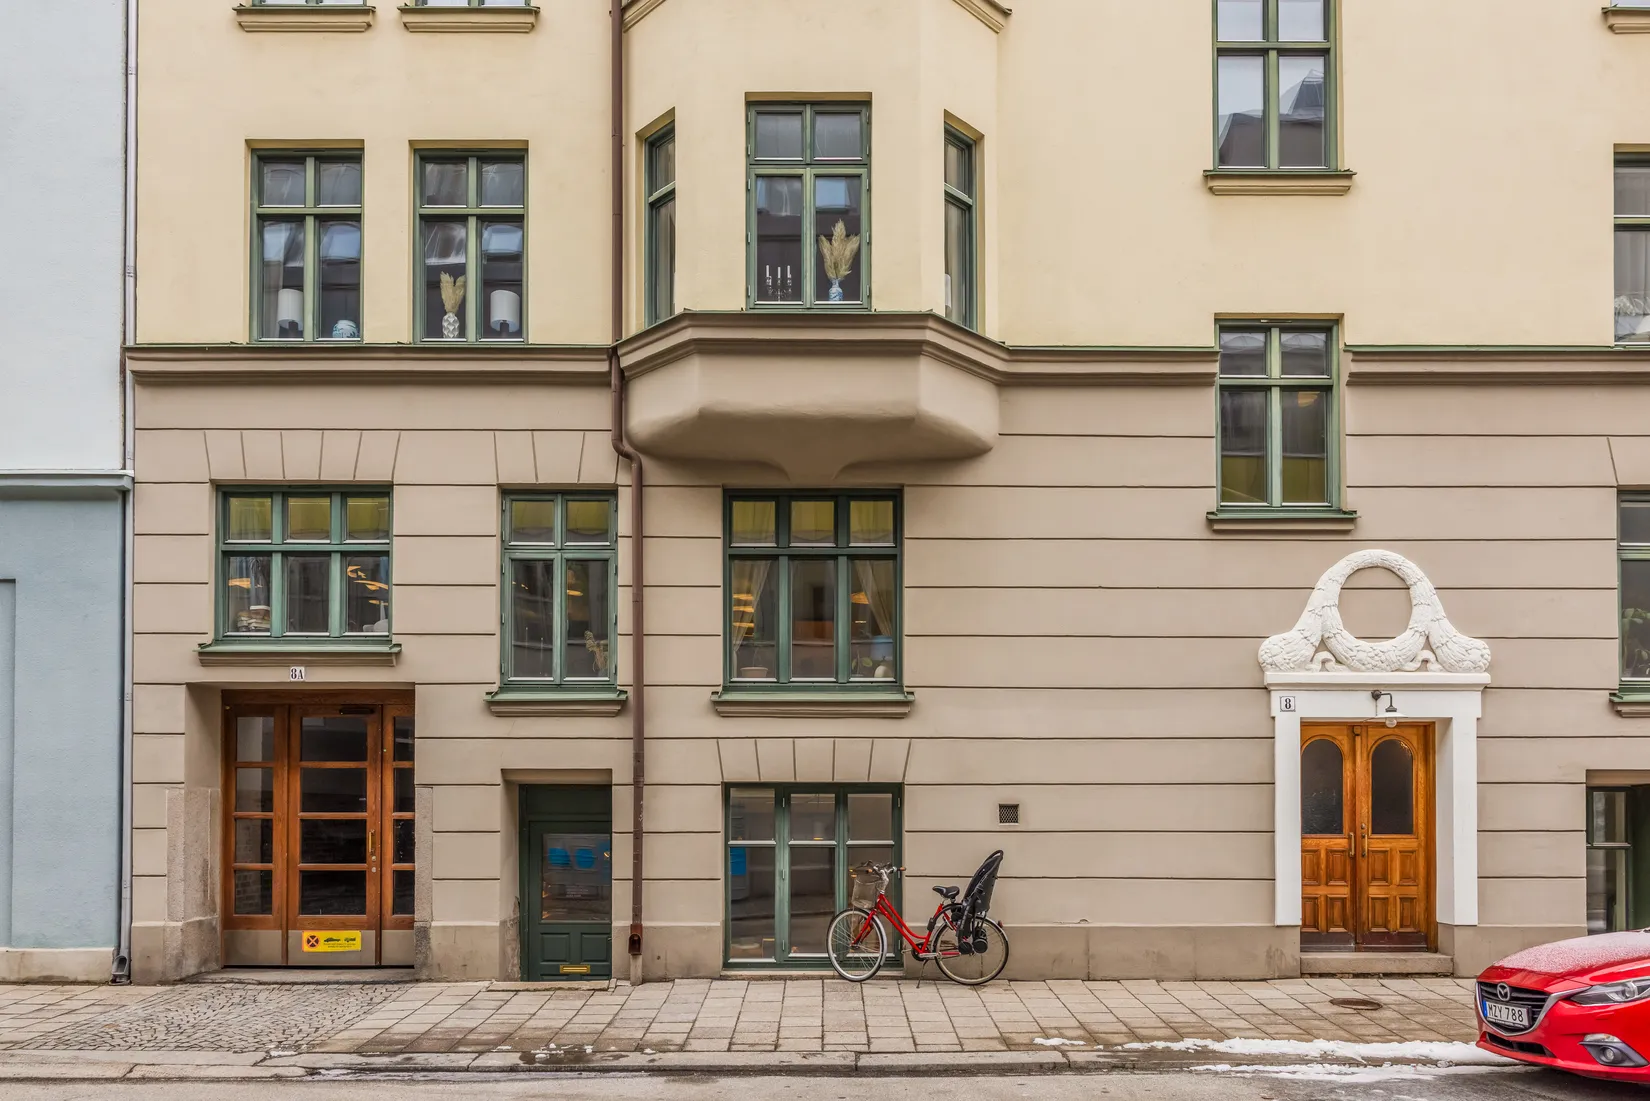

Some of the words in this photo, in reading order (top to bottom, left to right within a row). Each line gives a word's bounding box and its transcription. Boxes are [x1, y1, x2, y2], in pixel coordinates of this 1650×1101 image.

[291, 668, 303, 679] 8A
[1285, 698, 1292, 709] 8
[1488, 1004, 1503, 1018] MZY
[1505, 1007, 1524, 1022] 788
